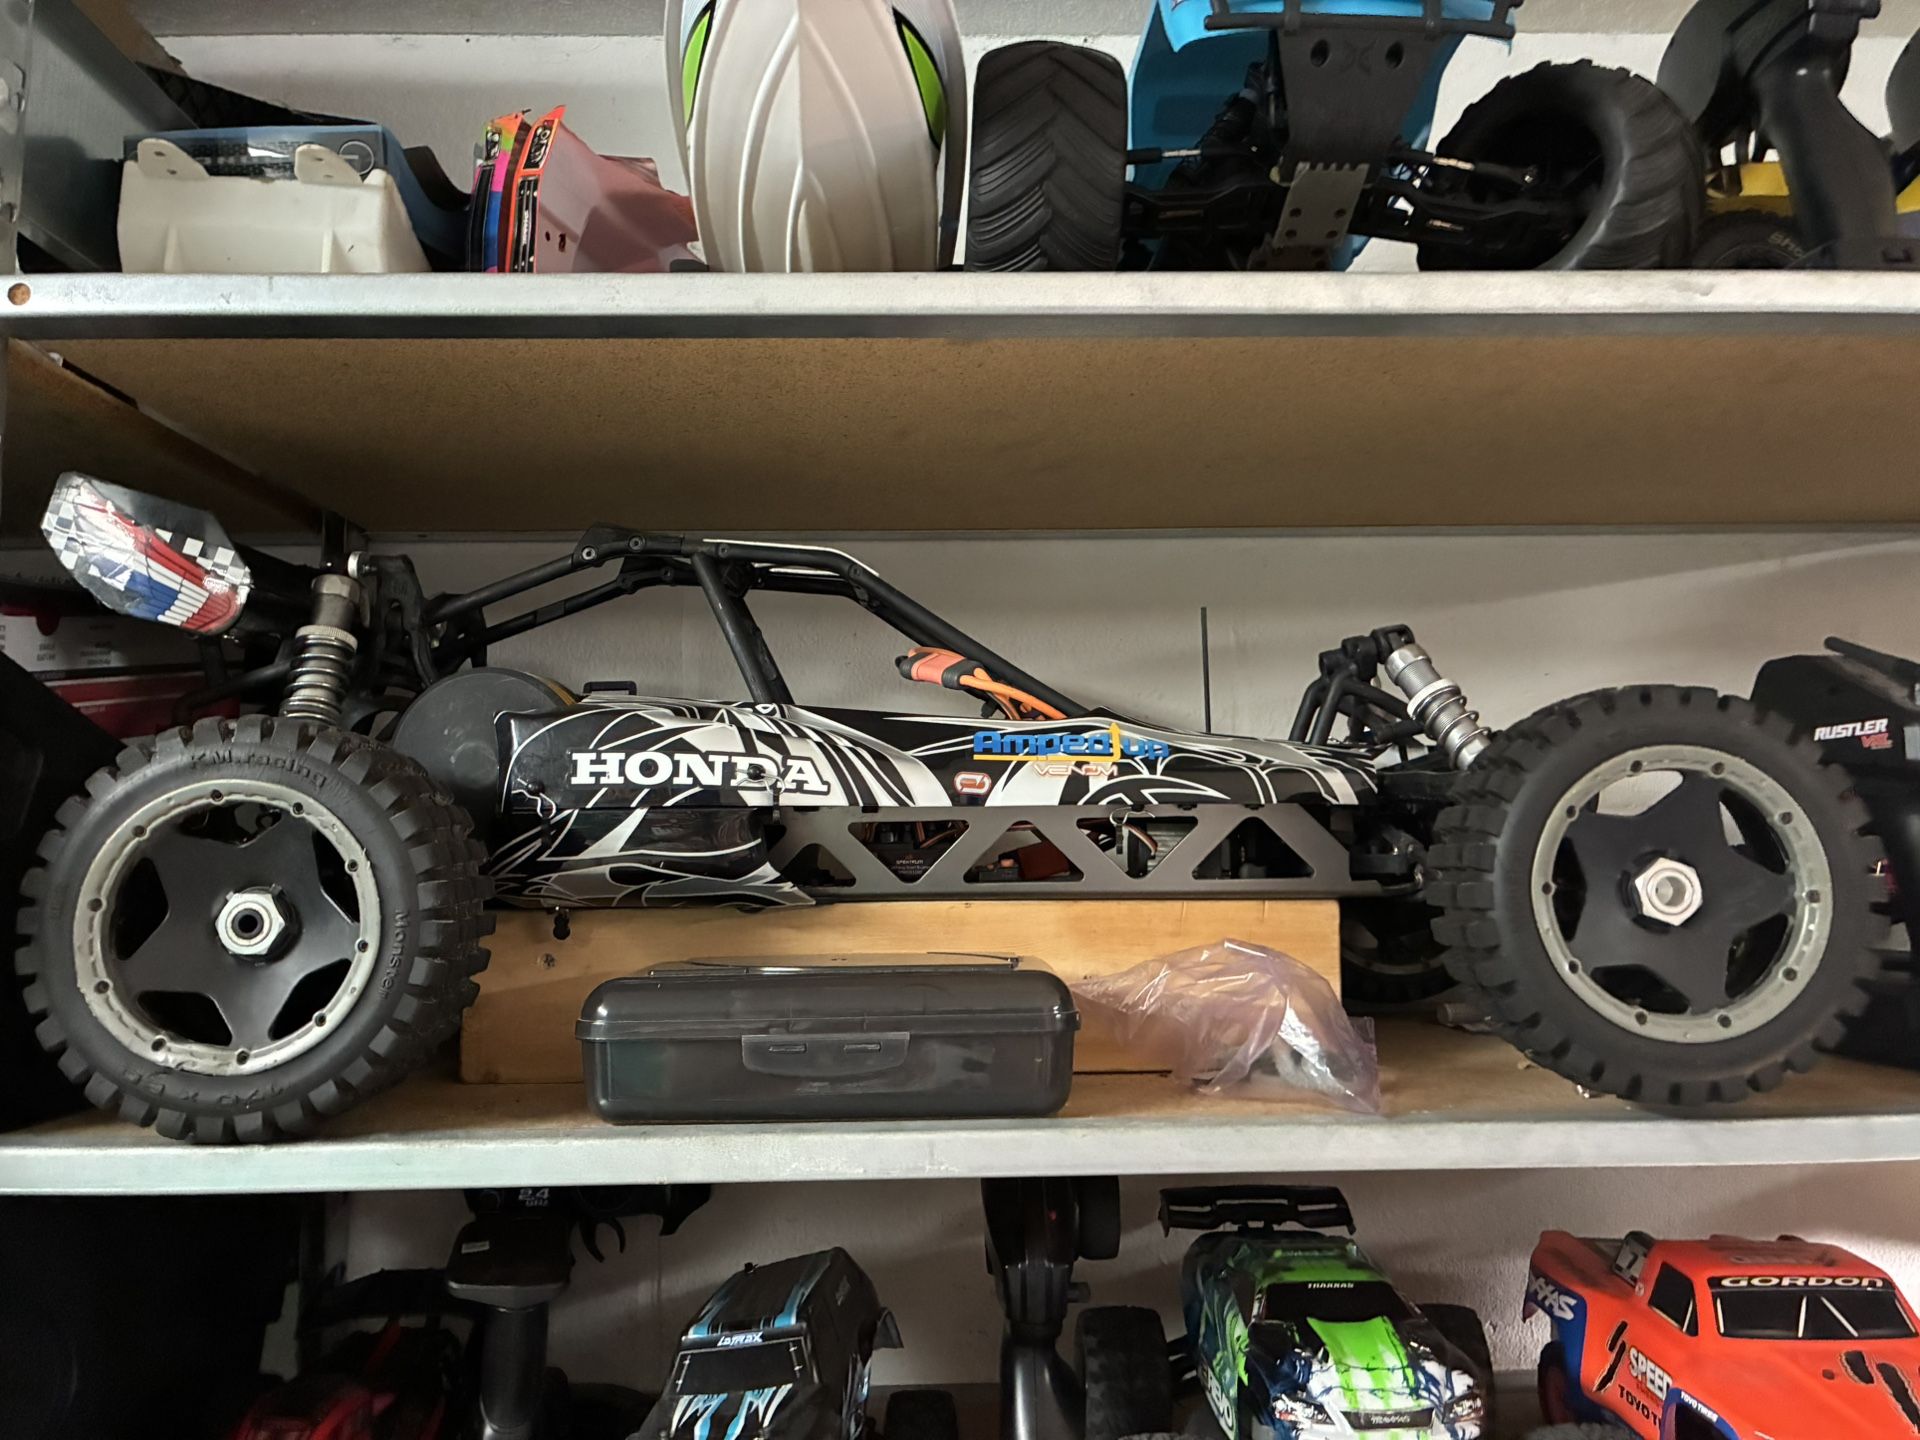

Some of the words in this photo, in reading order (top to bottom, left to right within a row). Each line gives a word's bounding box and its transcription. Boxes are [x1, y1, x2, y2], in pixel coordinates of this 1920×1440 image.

[1814, 718, 1888, 741] RUSTLER
[571, 752, 829, 793] HONDA
[1034, 763, 1118, 776] VENOM
[1618, 1384, 1650, 1420] TOYO
